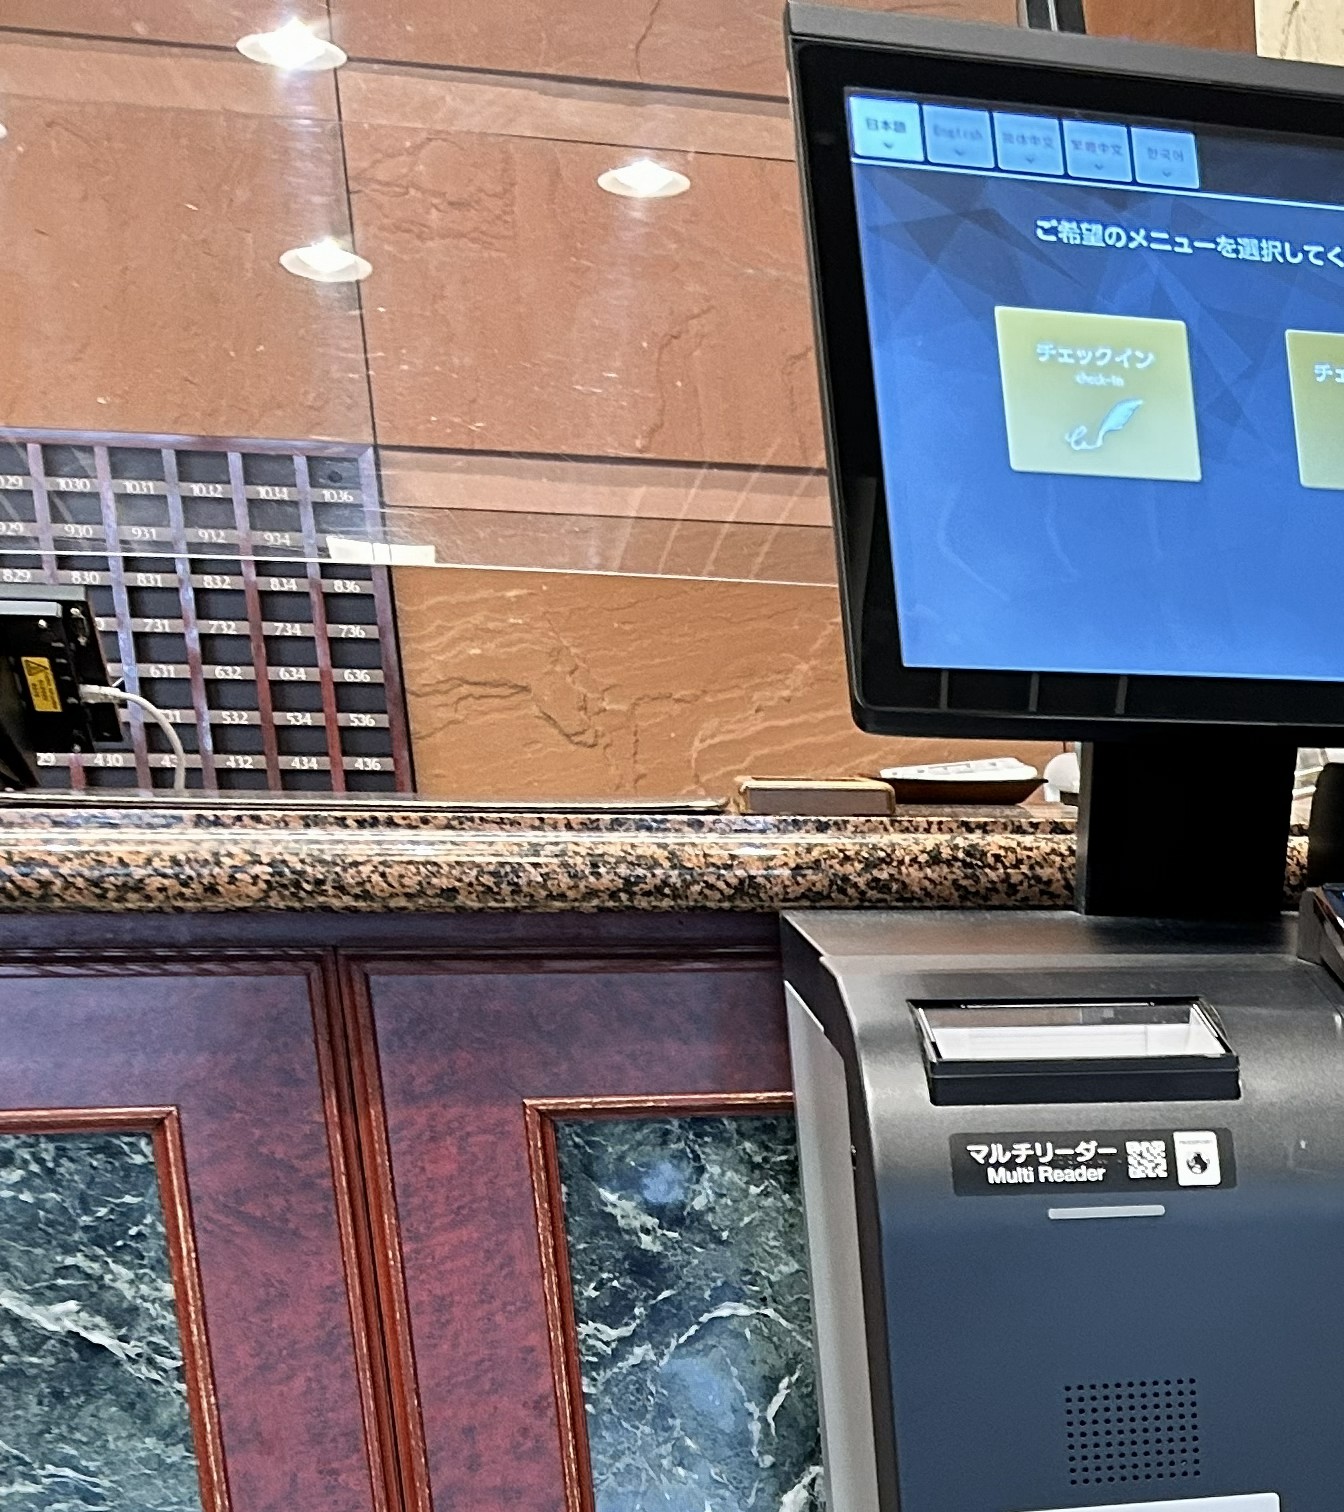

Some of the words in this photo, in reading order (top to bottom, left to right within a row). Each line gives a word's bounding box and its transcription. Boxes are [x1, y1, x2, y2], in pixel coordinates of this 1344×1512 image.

[866, 117, 907, 134] 日本語
[1036, 343, 1155, 369] チェックイン
[56, 478, 91, 491] 1030
[123, 480, 154, 494] 1031
[191, 483, 223, 497] 1032
[257, 487, 289, 500] 1034
[322, 490, 353, 502] 1036
[64, 525, 93, 537] 930
[132, 527, 157, 540] 931
[198, 529, 226, 542] 932
[264, 533, 290, 546] 934
[2, 569, 31, 582] 829
[71, 571, 100, 584] 830
[137, 573, 163, 586] 831
[203, 576, 232, 589] 832
[270, 578, 298, 591] 834
[333, 580, 360, 593] 836
[144, 619, 170, 631] 731
[208, 621, 237, 634] 732
[274, 623, 302, 636] 734
[339, 625, 366, 638] 736
[150, 664, 176, 677] 631
[215, 666, 242, 680] 632
[279, 668, 306, 681] 634
[344, 669, 371, 682] 636
[222, 711, 248, 724] 532
[286, 713, 312, 726] 534
[350, 714, 375, 727] 536
[37, 753, 56, 766] 29
[161, 755, 177, 767] 43
[226, 755, 253, 769] 432
[291, 757, 318, 770] 434
[355, 758, 381, 771] 436
[966, 1140, 1117, 1164] マルチリーダー
[987, 1166, 1035, 1184] Multi
[1038, 1165, 1107, 1183] Reader
